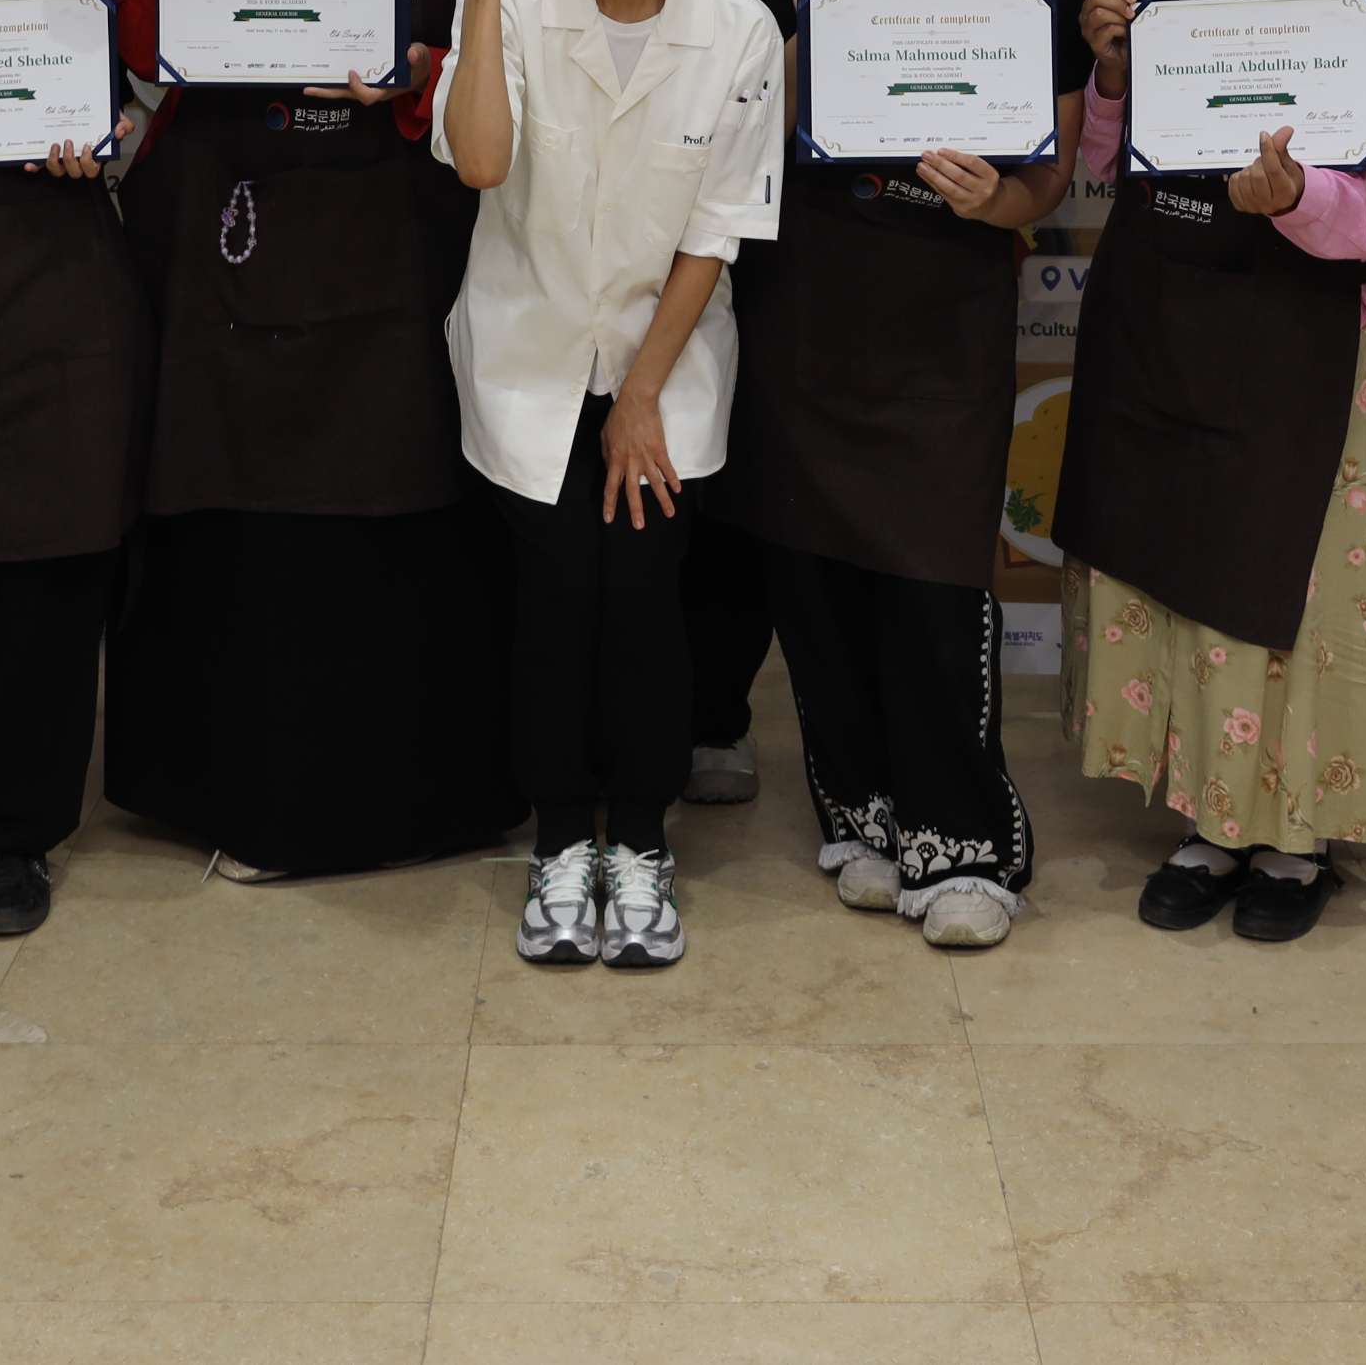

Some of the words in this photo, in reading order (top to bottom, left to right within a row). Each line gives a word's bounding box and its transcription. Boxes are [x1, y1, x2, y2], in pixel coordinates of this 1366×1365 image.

[870, 13, 921, 26] Certificate
[925, 14, 935, 24] of
[940, 12, 992, 25] completion
[0, 20, 48, 34] completion
[1190, 27, 1240, 38] Certificate
[1244, 25, 1255, 35] of
[1259, 23, 1311, 35] completion
[847, 49, 890, 61] Salma
[895, 47, 966, 60] Mahmoud
[971, 46, 1017, 60] Shafik
[1155, 60, 1232, 75] Mennatalla
[1313, 55, 1347, 68] Badr
[294, 107, 351, 124] 한국문화원
[684, 135, 705, 145] Prof.
[1085, 181, 1116, 199] Ma
[1155, 190, 1214, 217] 한국문화원
[1029, 322, 1077, 337] Cultu
